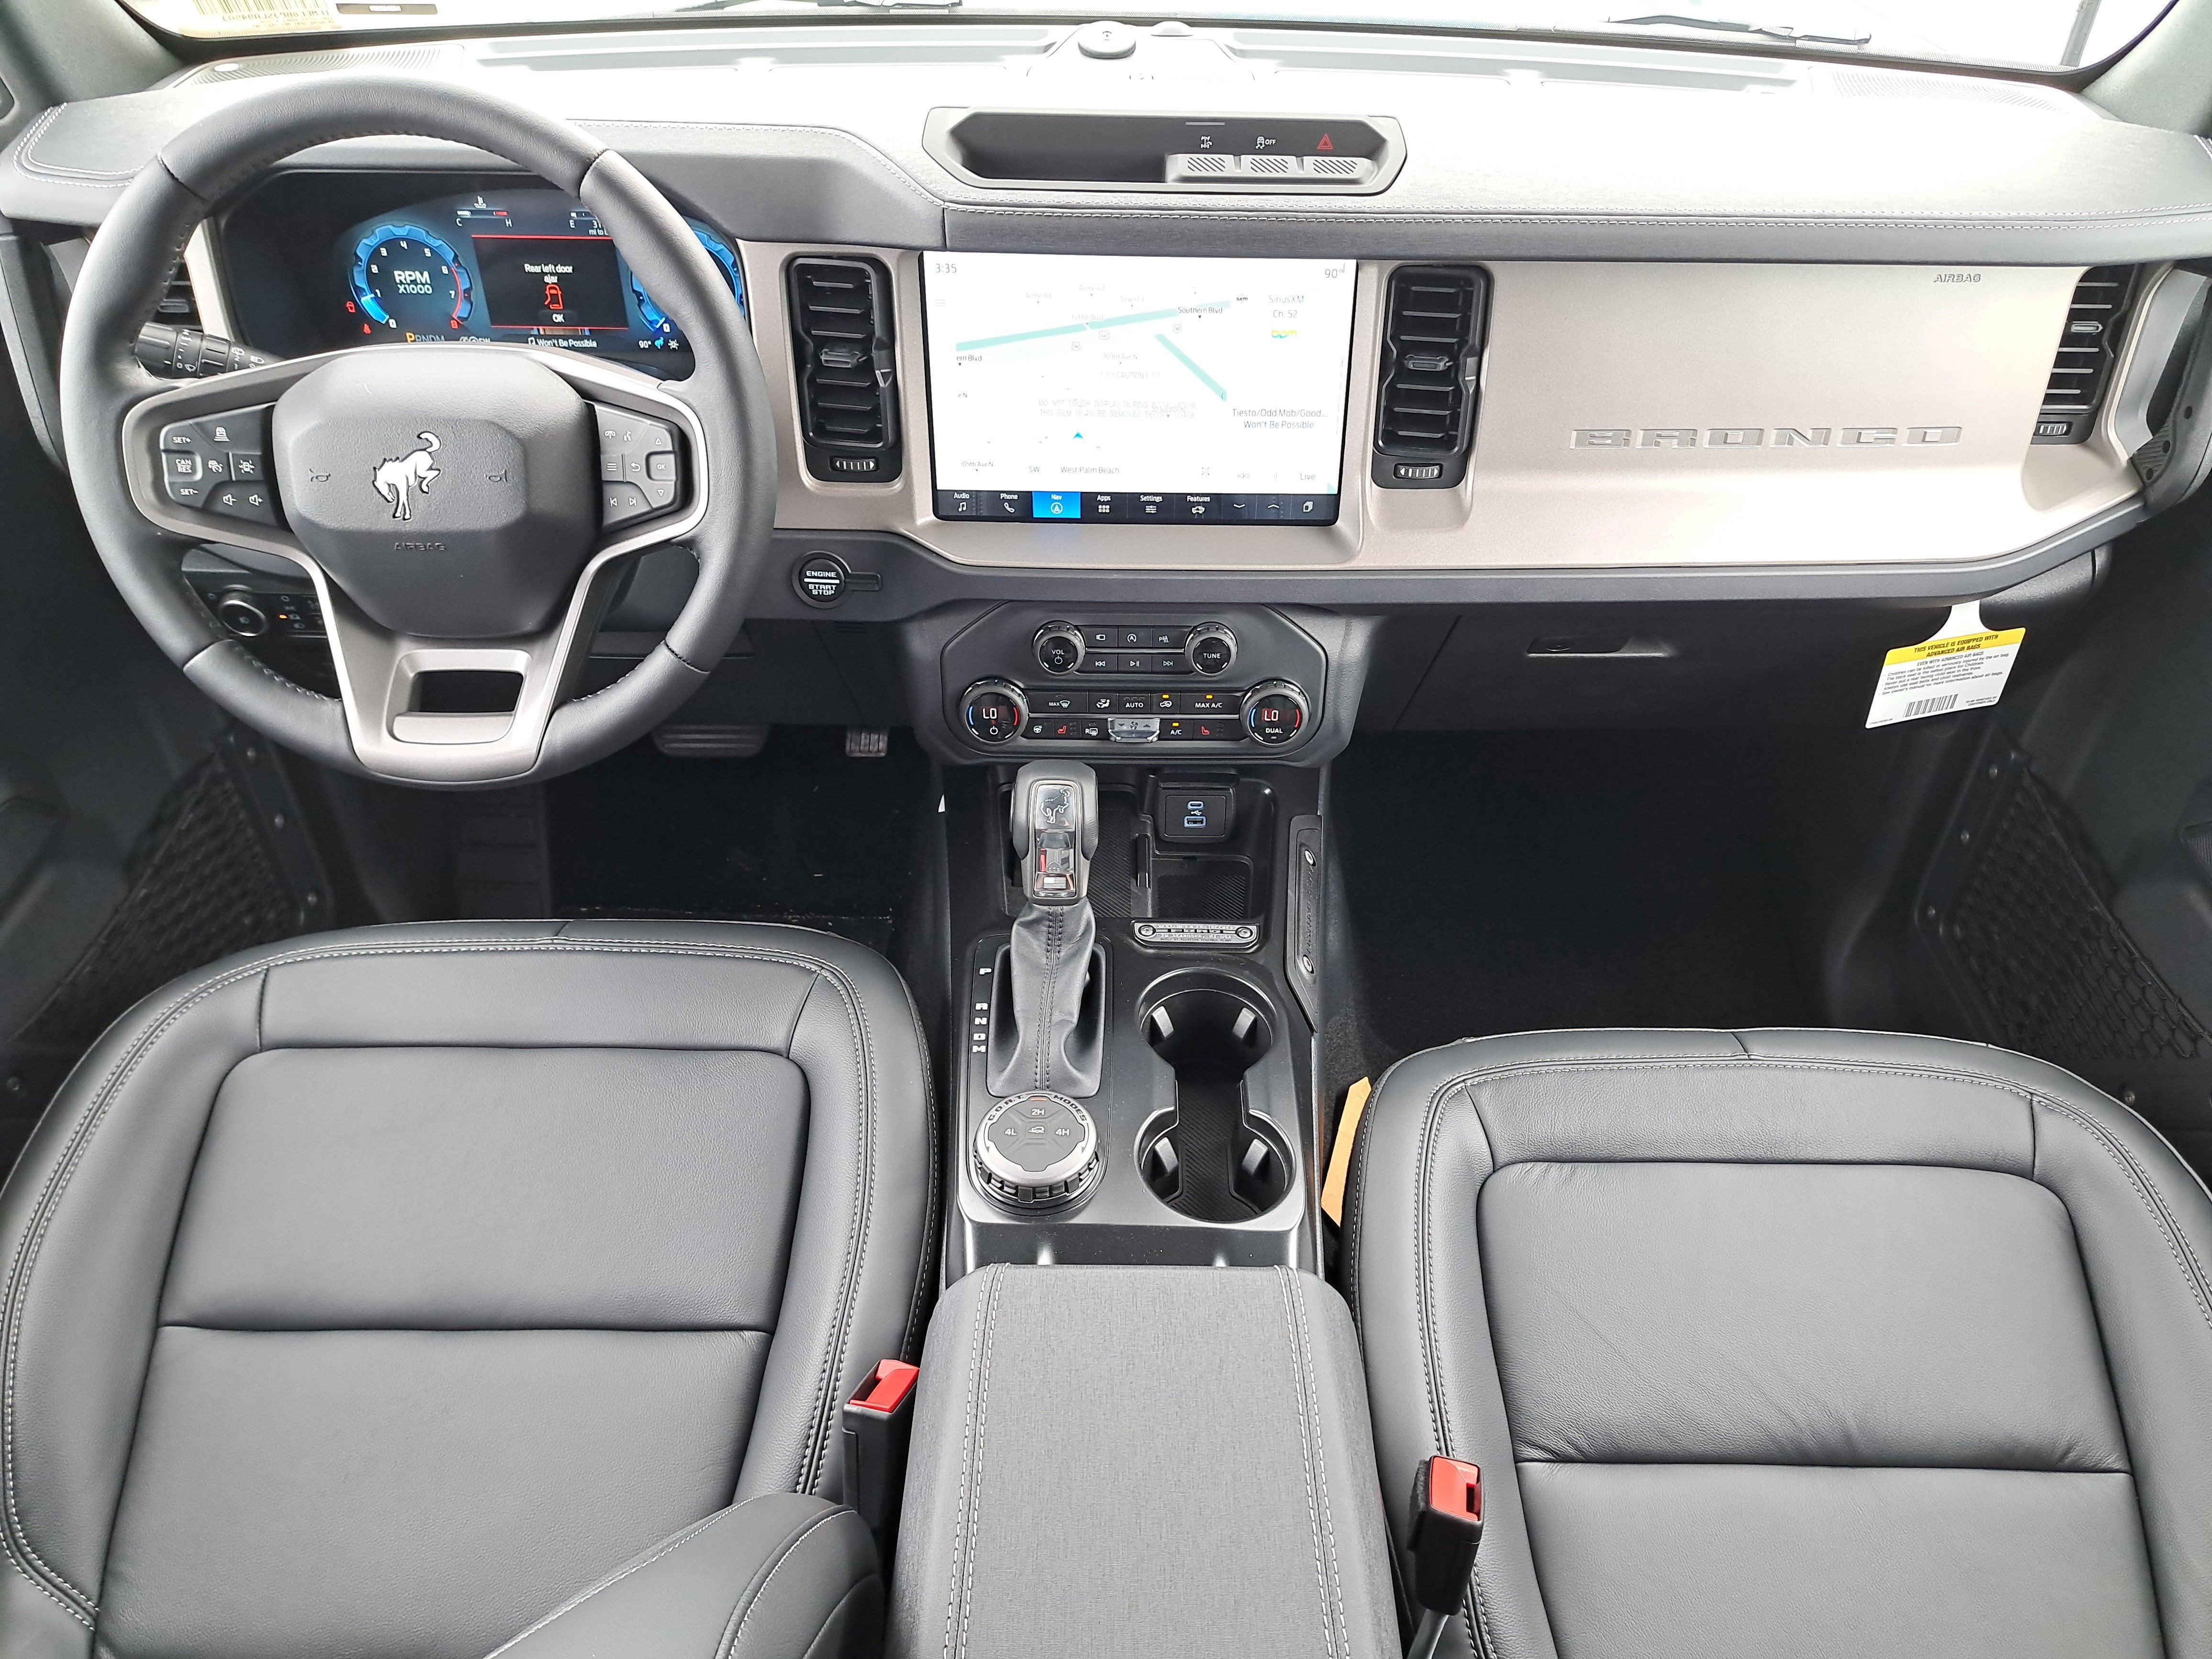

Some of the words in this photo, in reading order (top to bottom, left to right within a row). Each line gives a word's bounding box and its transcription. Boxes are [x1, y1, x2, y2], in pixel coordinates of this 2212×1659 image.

[506, 219, 512, 227] H
[400, 241, 408, 250] 4
[424, 249, 431, 257] 5
[371, 265, 378, 273] 2
[442, 266, 449, 274] 6
[524, 264, 542, 272] Rear
[542, 264, 555, 273] left
[556, 264, 573, 273] door
[935, 264, 957, 273] 3:35
[393, 271, 430, 283] RPM
[544, 275, 558, 283] ajar
[1934, 274, 1980, 282] AIRBAG
[376, 289, 381, 298] 1
[398, 285, 432, 294] X1000
[450, 290, 455, 299] 7
[1269, 295, 1304, 303] SiriusXM
[552, 314, 564, 322] OK
[1273, 310, 1285, 318] Ch.
[1288, 310, 1297, 318] 52
[388, 320, 397, 328] 0
[537, 338, 558, 347] Won't
[559, 339, 568, 347] Be
[569, 339, 597, 348] Possible
[639, 340, 651, 349] 90°
[1570, 426, 1963, 449] BRONCO
[1957, 637, 1983, 645] EQUIPPED
[1926, 648, 1955, 657] ADVANCED
[983, 708, 997, 719] LO
[1264, 710, 1278, 721] LO
[1053, 1095, 1087, 1121] MODES
